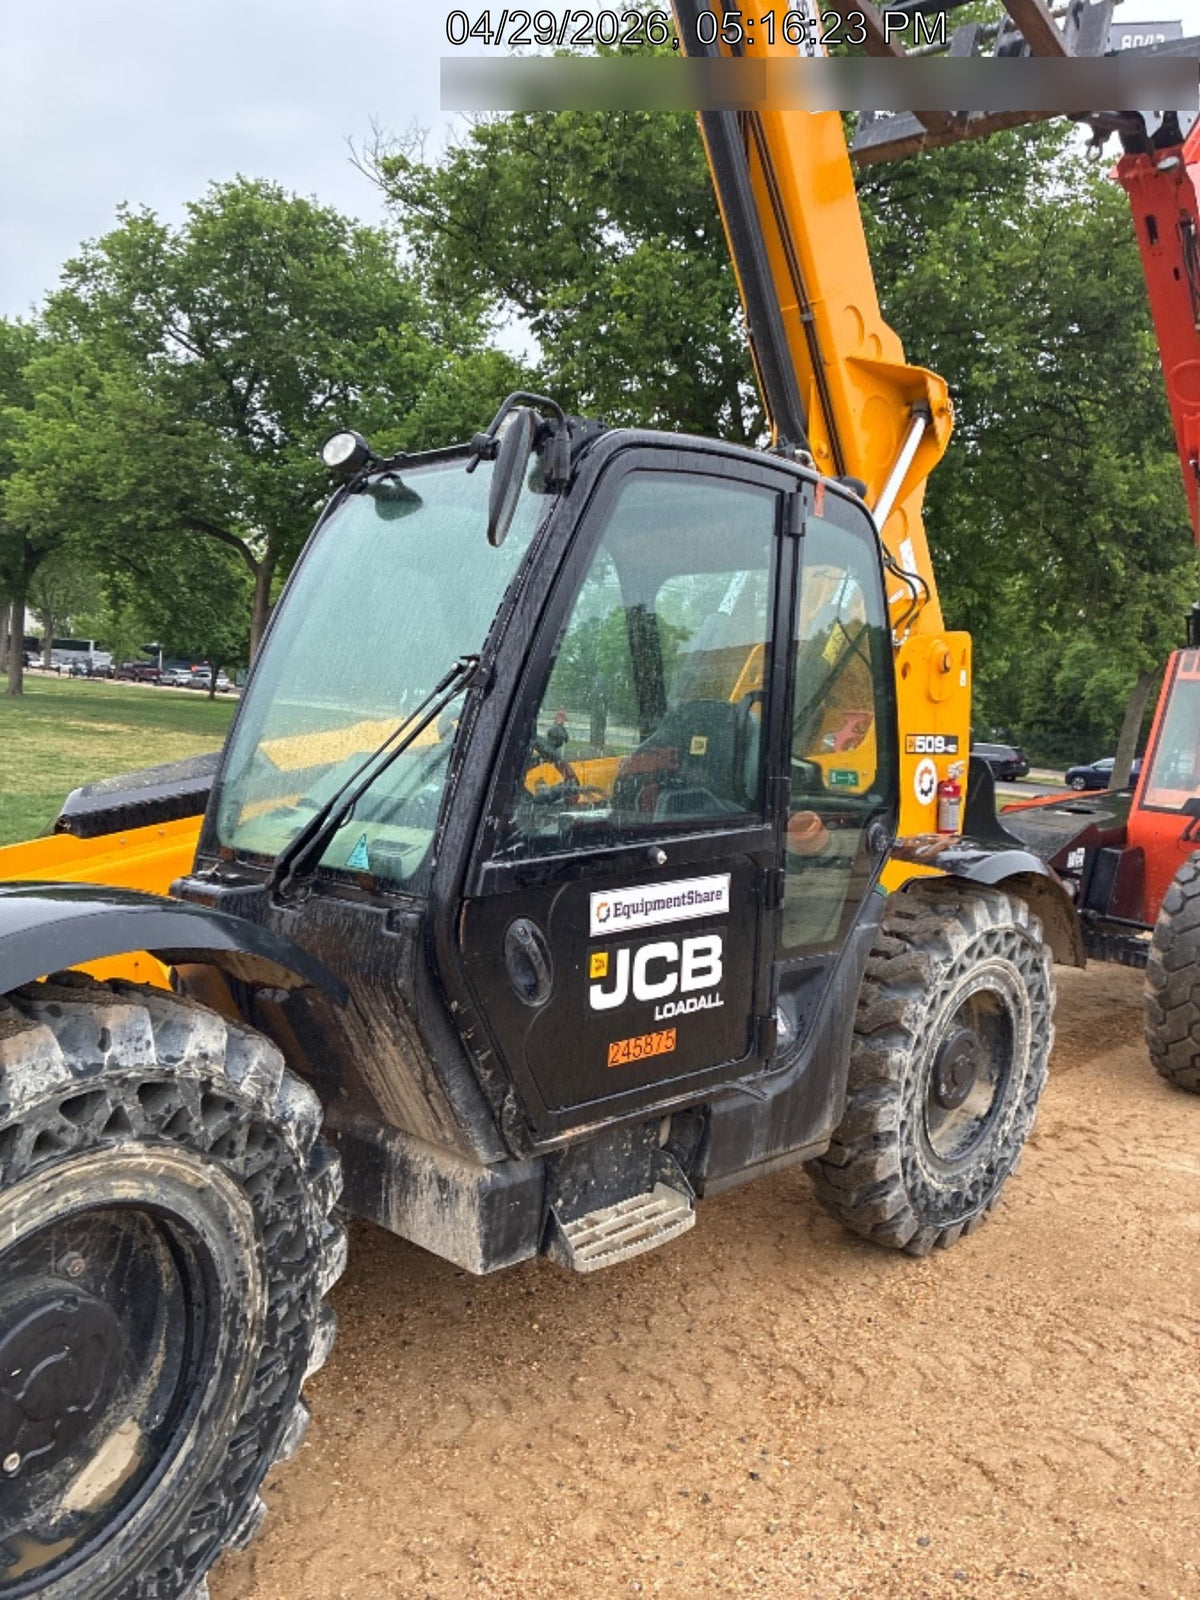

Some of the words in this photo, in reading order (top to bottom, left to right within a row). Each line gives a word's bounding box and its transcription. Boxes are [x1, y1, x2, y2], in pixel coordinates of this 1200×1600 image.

[612, 889, 723, 919] EquipmentShare
[590, 934, 724, 1010] JCB
[654, 993, 724, 1022] LOADALL
[610, 1030, 676, 1066] 245875
